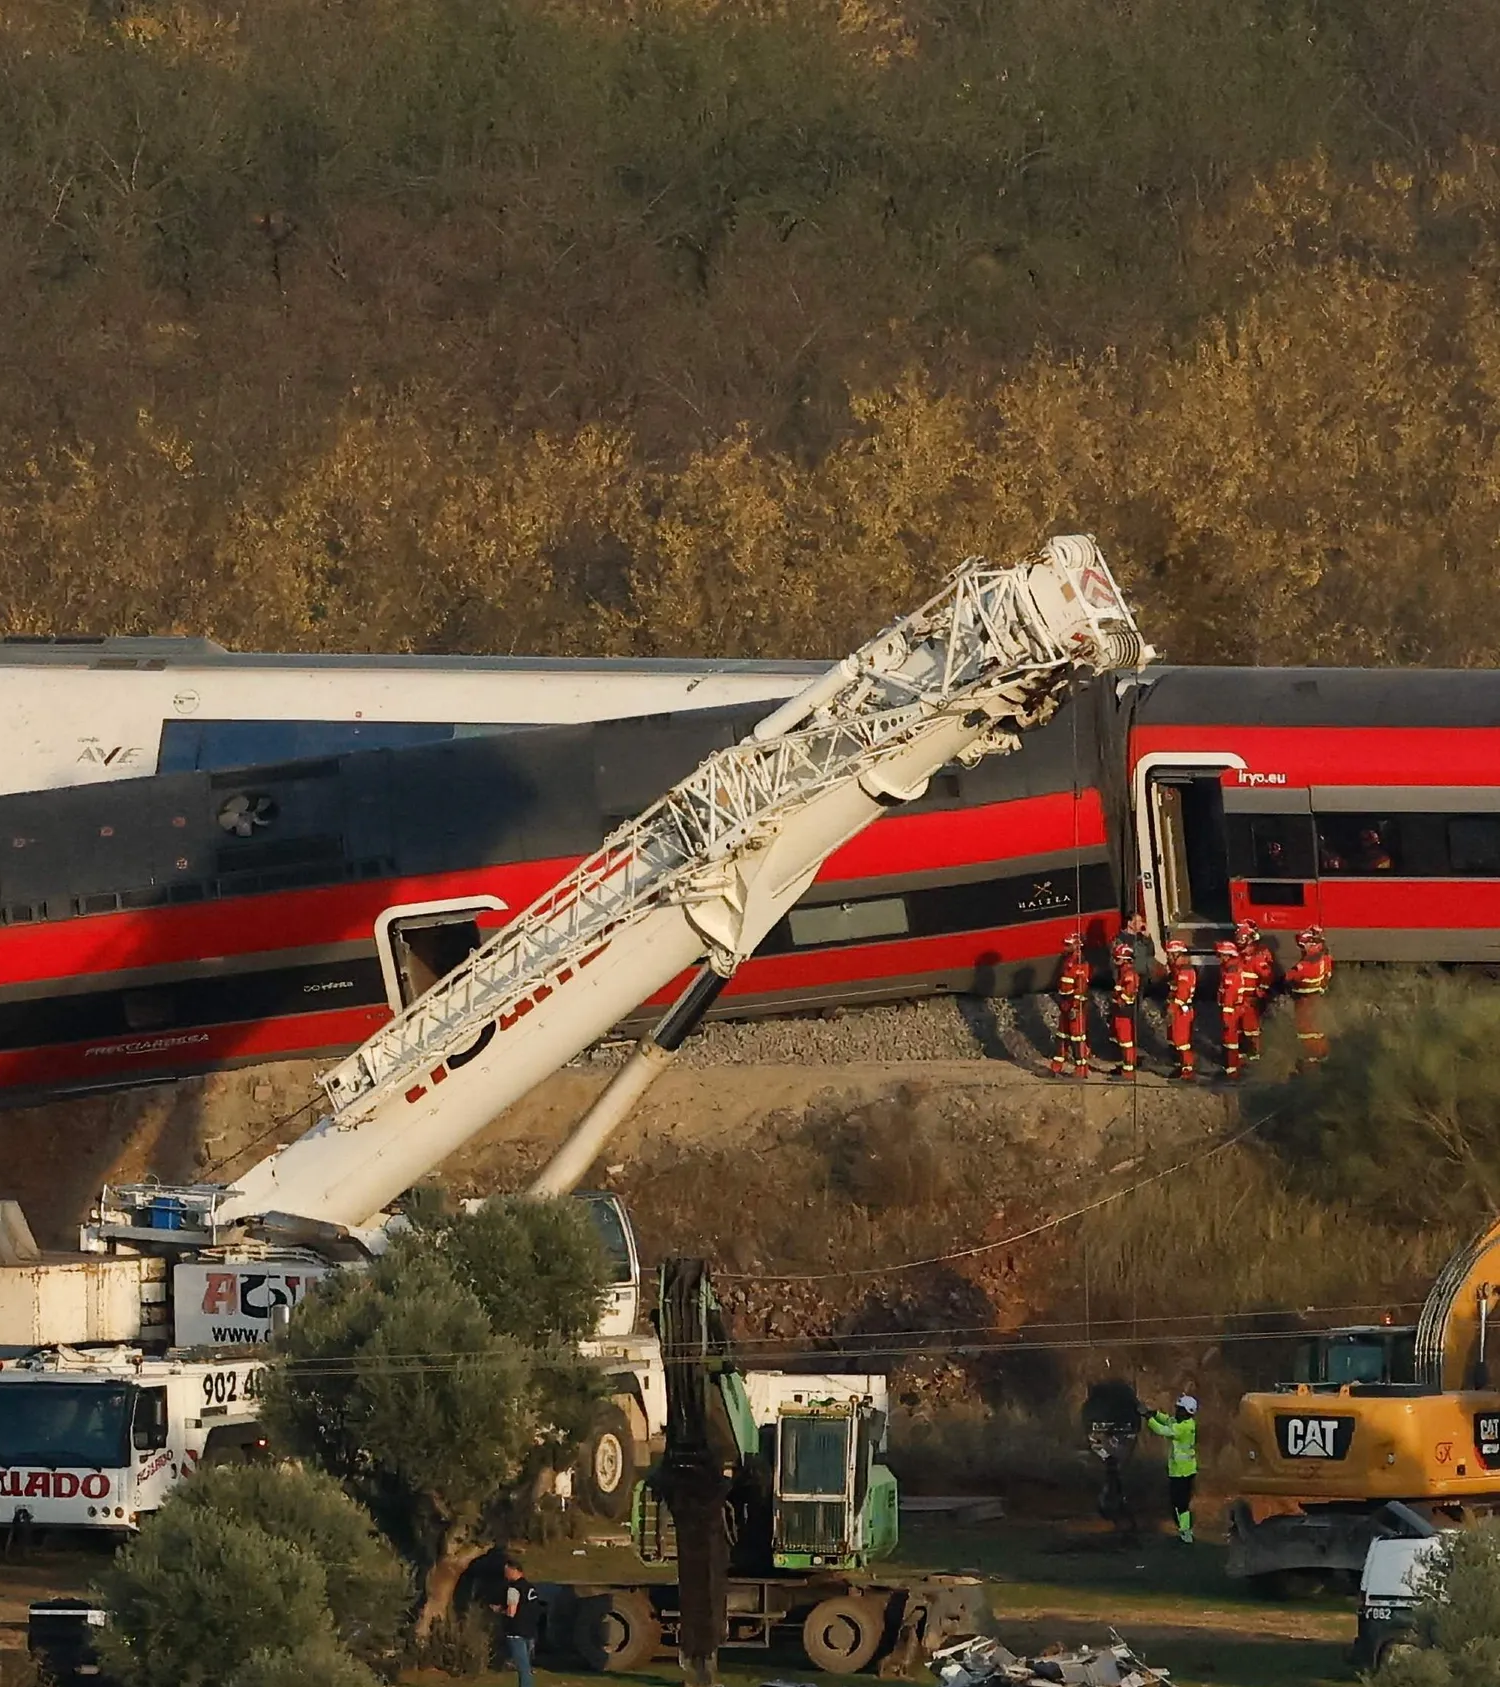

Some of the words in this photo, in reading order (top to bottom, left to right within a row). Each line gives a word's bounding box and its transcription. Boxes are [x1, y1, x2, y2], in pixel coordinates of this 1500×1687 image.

[76, 746, 144, 767] AVE
[203, 1371, 238, 1405] 902
[1288, 1418, 1339, 1457] CAT
[1480, 1418, 1500, 1441] CAT
